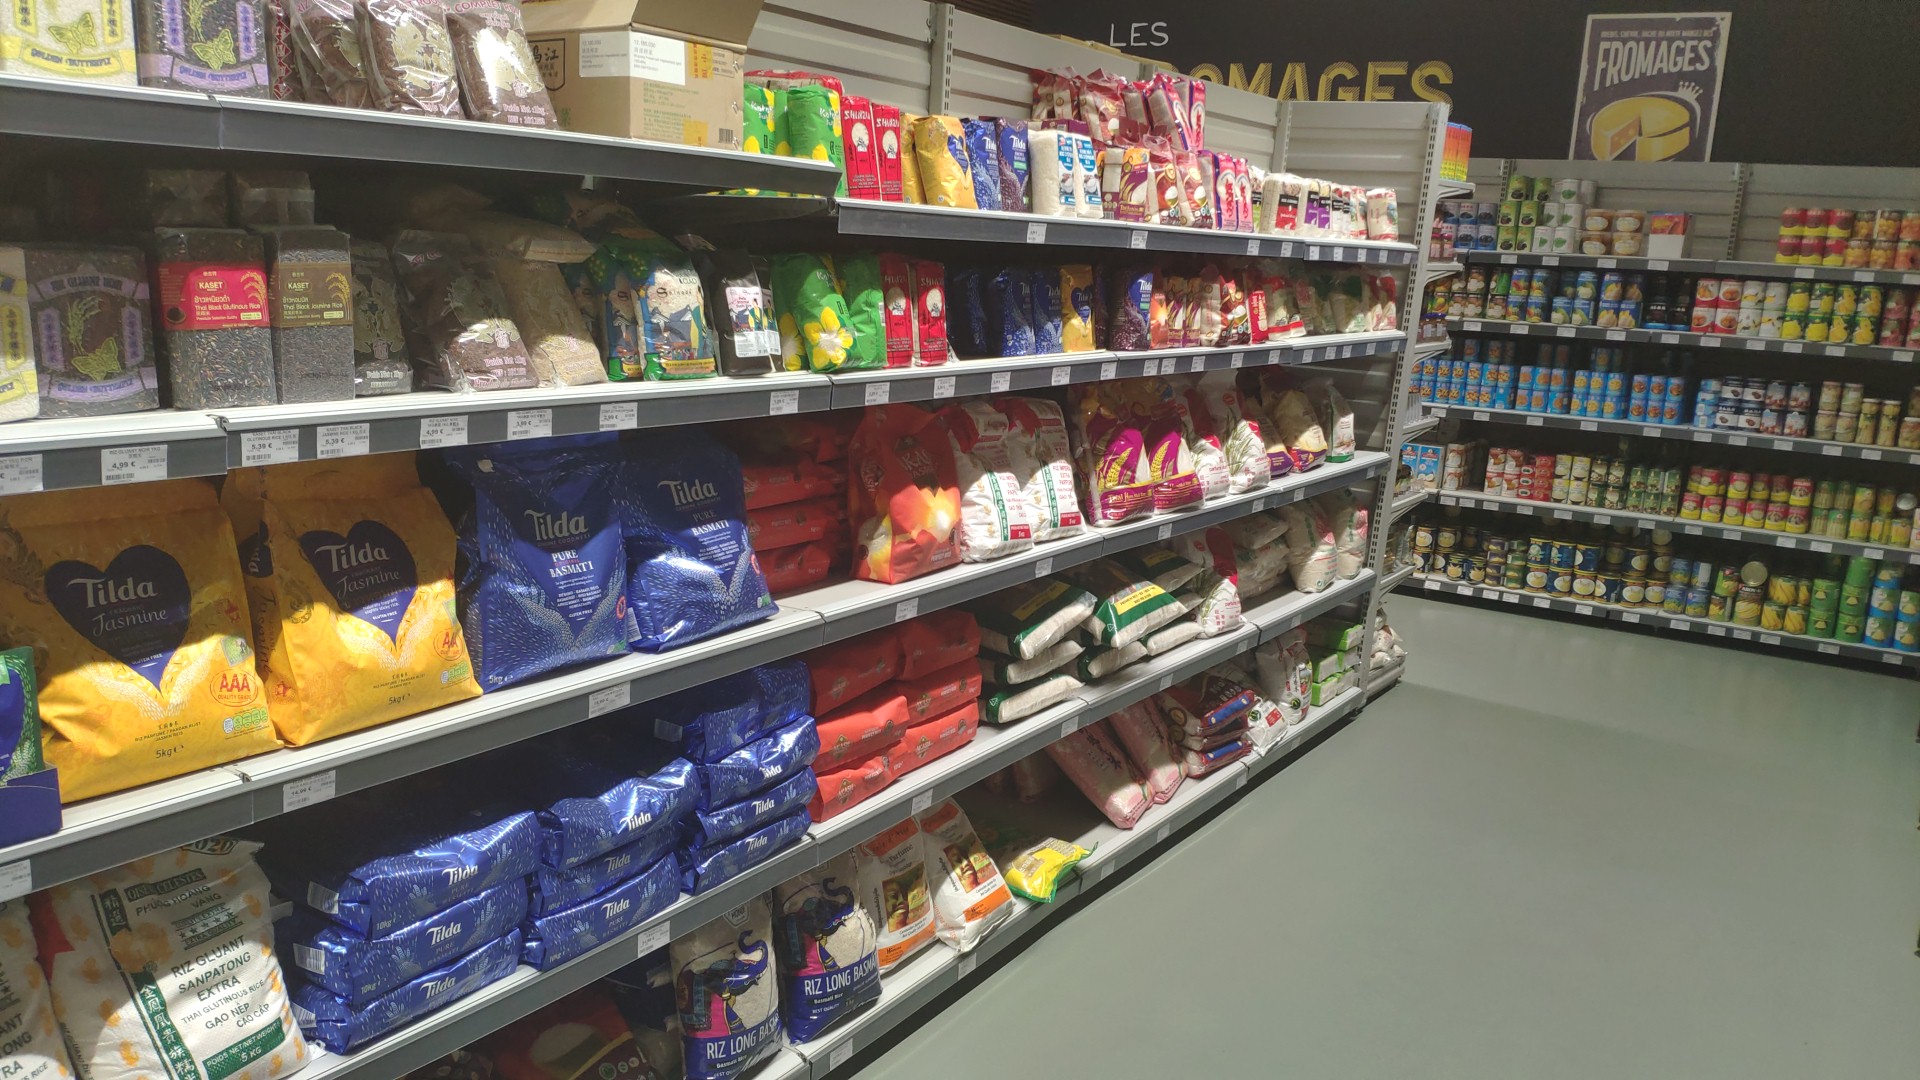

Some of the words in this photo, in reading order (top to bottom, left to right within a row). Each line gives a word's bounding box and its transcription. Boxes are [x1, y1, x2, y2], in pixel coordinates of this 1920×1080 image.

[1109, 22, 1169, 47] LES
[1594, 40, 1712, 91] FROMAGES
[1172, 60, 1454, 117] MAGES
[1009, 135, 1026, 150] Tilda
[657, 479, 718, 506] Tilda
[524, 510, 588, 540] Tilda
[692, 510, 717, 522] PURE
[691, 520, 730, 536] BASMATI
[314, 542, 391, 572] Tilda
[552, 550, 578, 562] PURE
[549, 560, 594, 578] BASMATI
[66, 577, 158, 608] Tilda
[336, 571, 400, 599] Jasmine
[92, 610, 169, 637] Jasmine
[219, 672, 251, 692] AAA
[489, 674, 503, 684] 5kg
[156, 748, 172, 759] 5kg
[758, 764, 782, 780] Tilda
[751, 798, 775, 816] Tilda
[620, 812, 652, 831] Tilda
[188, 838, 232, 850] 020
[746, 834, 768, 852] Tilda
[604, 853, 630, 873] Tilda
[442, 864, 478, 886] Tilda
[600, 898, 630, 920] Tilda
[207, 918, 238, 936] QUALITY
[426, 922, 462, 946] Tilda
[170, 960, 194, 978] RIZ
[196, 934, 245, 966] GLUANT
[178, 952, 252, 994] SANPATONG
[804, 978, 823, 996] RIZ
[826, 968, 851, 992] LONG
[196, 975, 242, 1002] EXTRA
[420, 976, 456, 1000] Tilda
[181, 1010, 202, 1024] THAI
[202, 990, 248, 1014] GLUTINOUS
[248, 980, 264, 992] RICE
[814, 996, 834, 1005] Basmati
[824, 1003, 840, 1012] QUALITY
[0, 1012, 24, 1034] ANT
[236, 1015, 254, 1028] CAO
[0, 1031, 33, 1057] ONG
[241, 1053, 248, 1062] 5
[250, 1046, 262, 1058] KG
[706, 1041, 726, 1060] RIZ
[730, 1030, 756, 1056] LONG
[31, 1061, 48, 1078] RICE
[716, 1058, 738, 1070] Basmati
[738, 1054, 748, 1064] Rice
